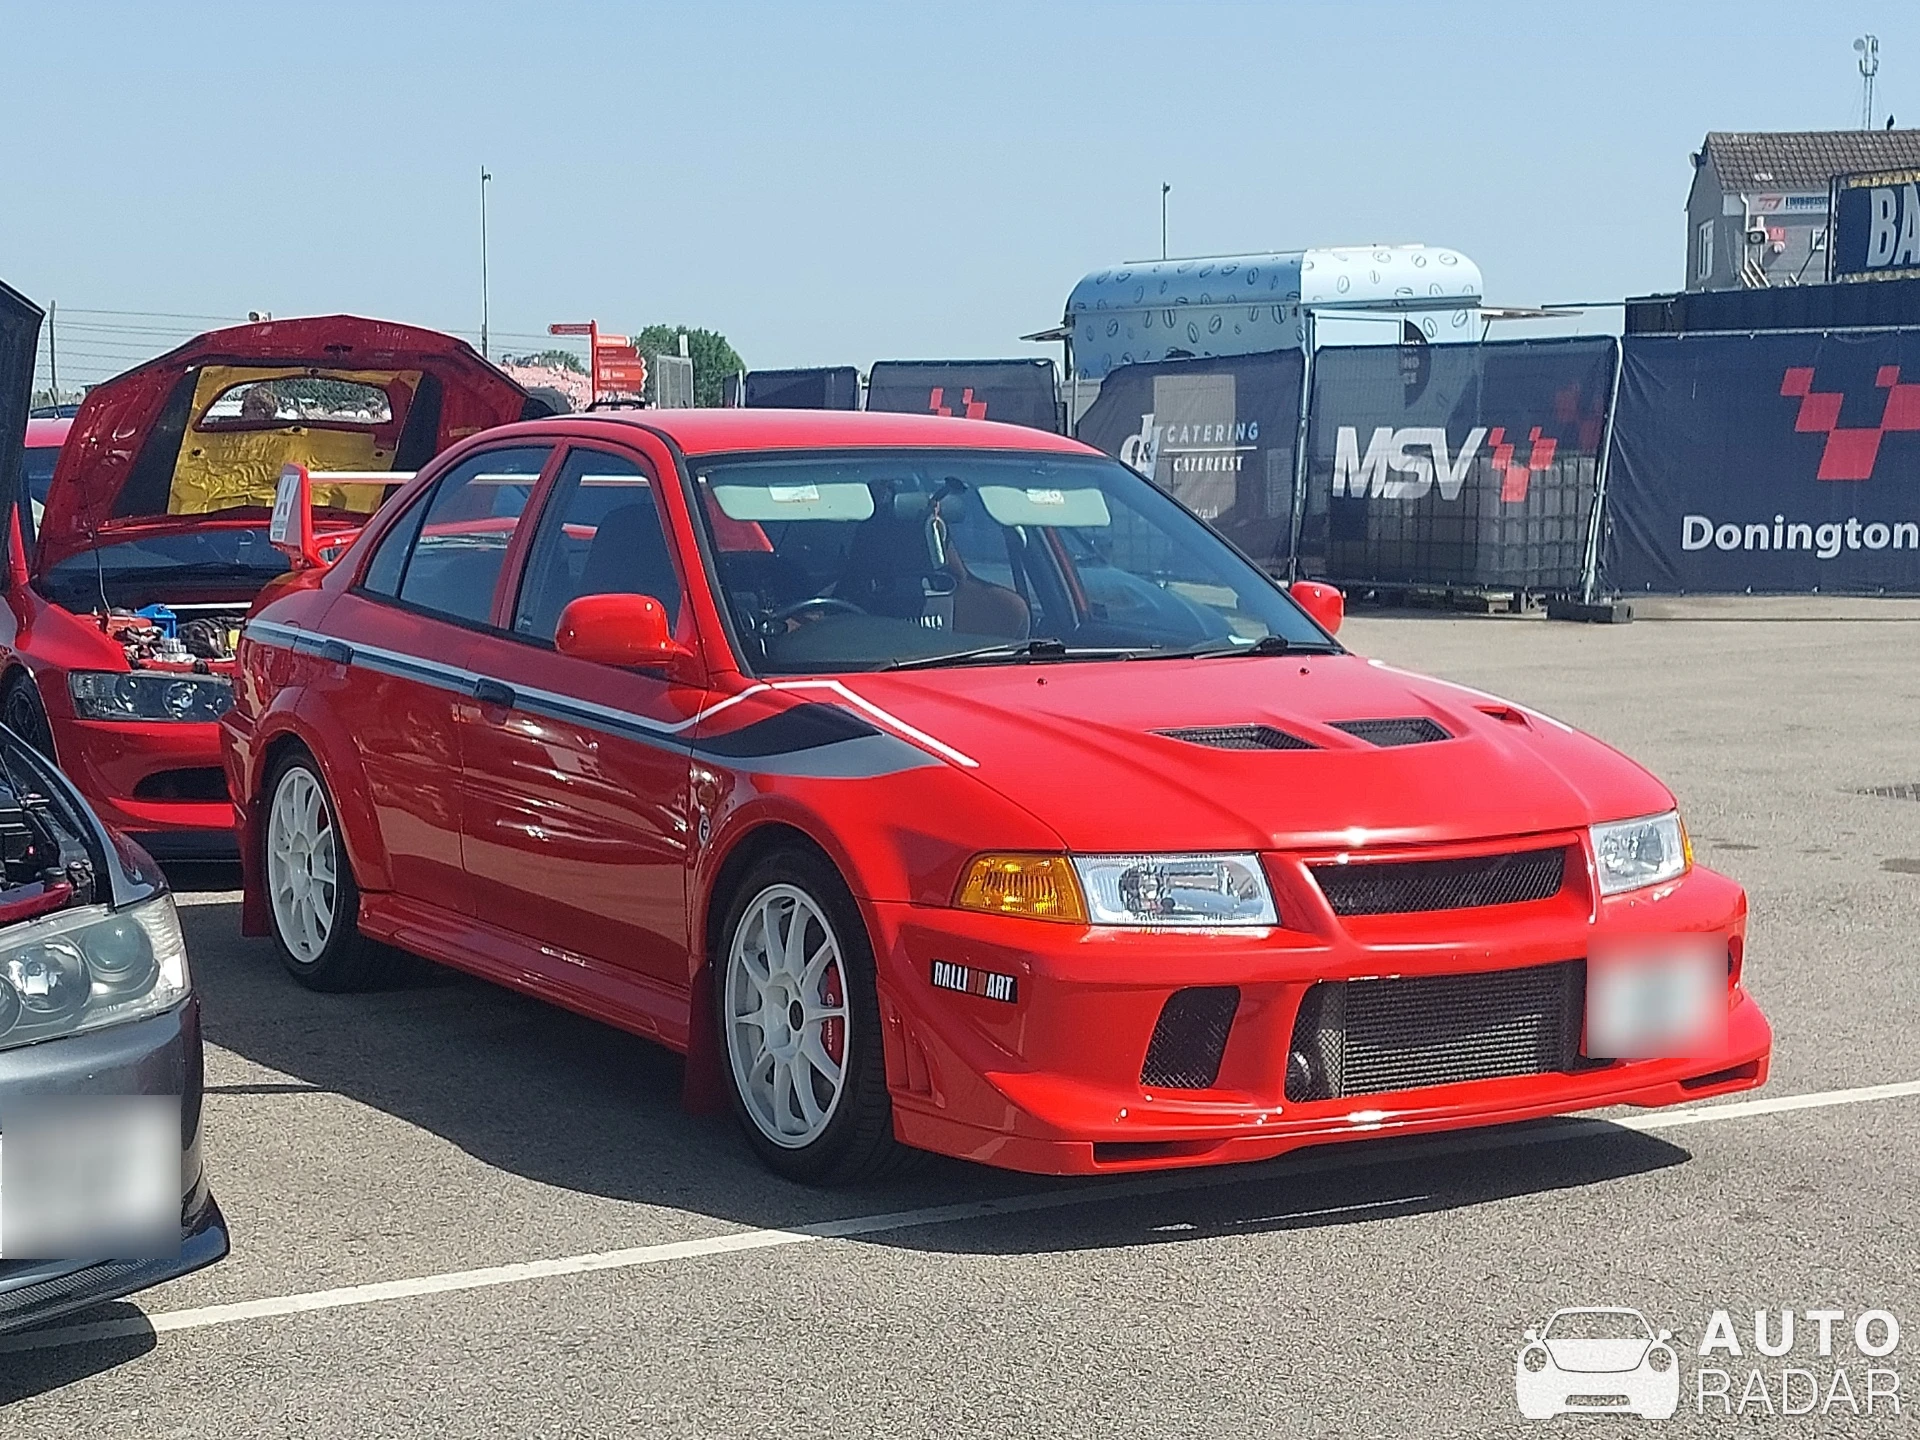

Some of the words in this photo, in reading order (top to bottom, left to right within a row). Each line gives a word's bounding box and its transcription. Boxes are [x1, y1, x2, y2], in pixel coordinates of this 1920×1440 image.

[1167, 421, 1258, 444] CATERING
[1333, 427, 1487, 500] MSV
[1682, 514, 1919, 558] Donington
